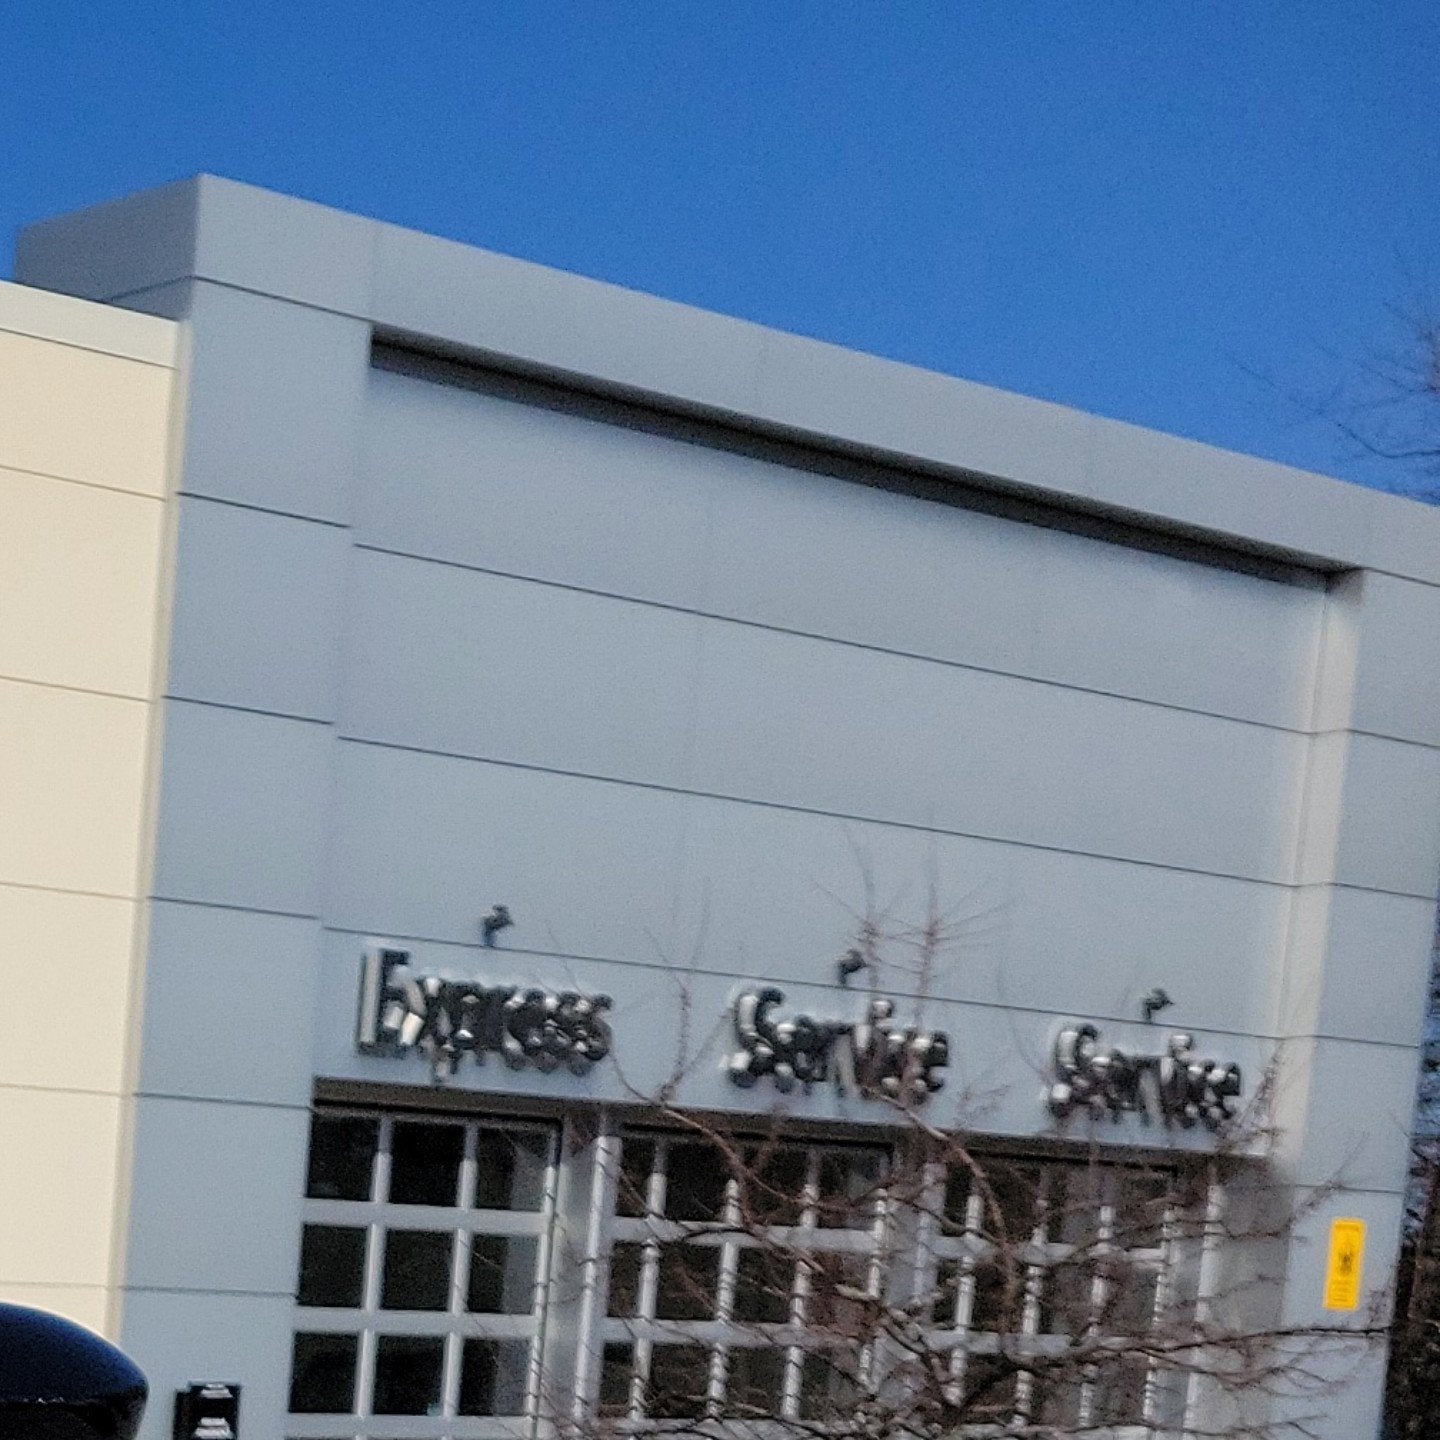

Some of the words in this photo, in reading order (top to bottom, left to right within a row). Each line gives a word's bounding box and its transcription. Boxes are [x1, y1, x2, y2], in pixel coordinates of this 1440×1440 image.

[358, 949, 614, 1079] Express
[723, 988, 950, 1105] Service
[1044, 1022, 1242, 1131] Service
